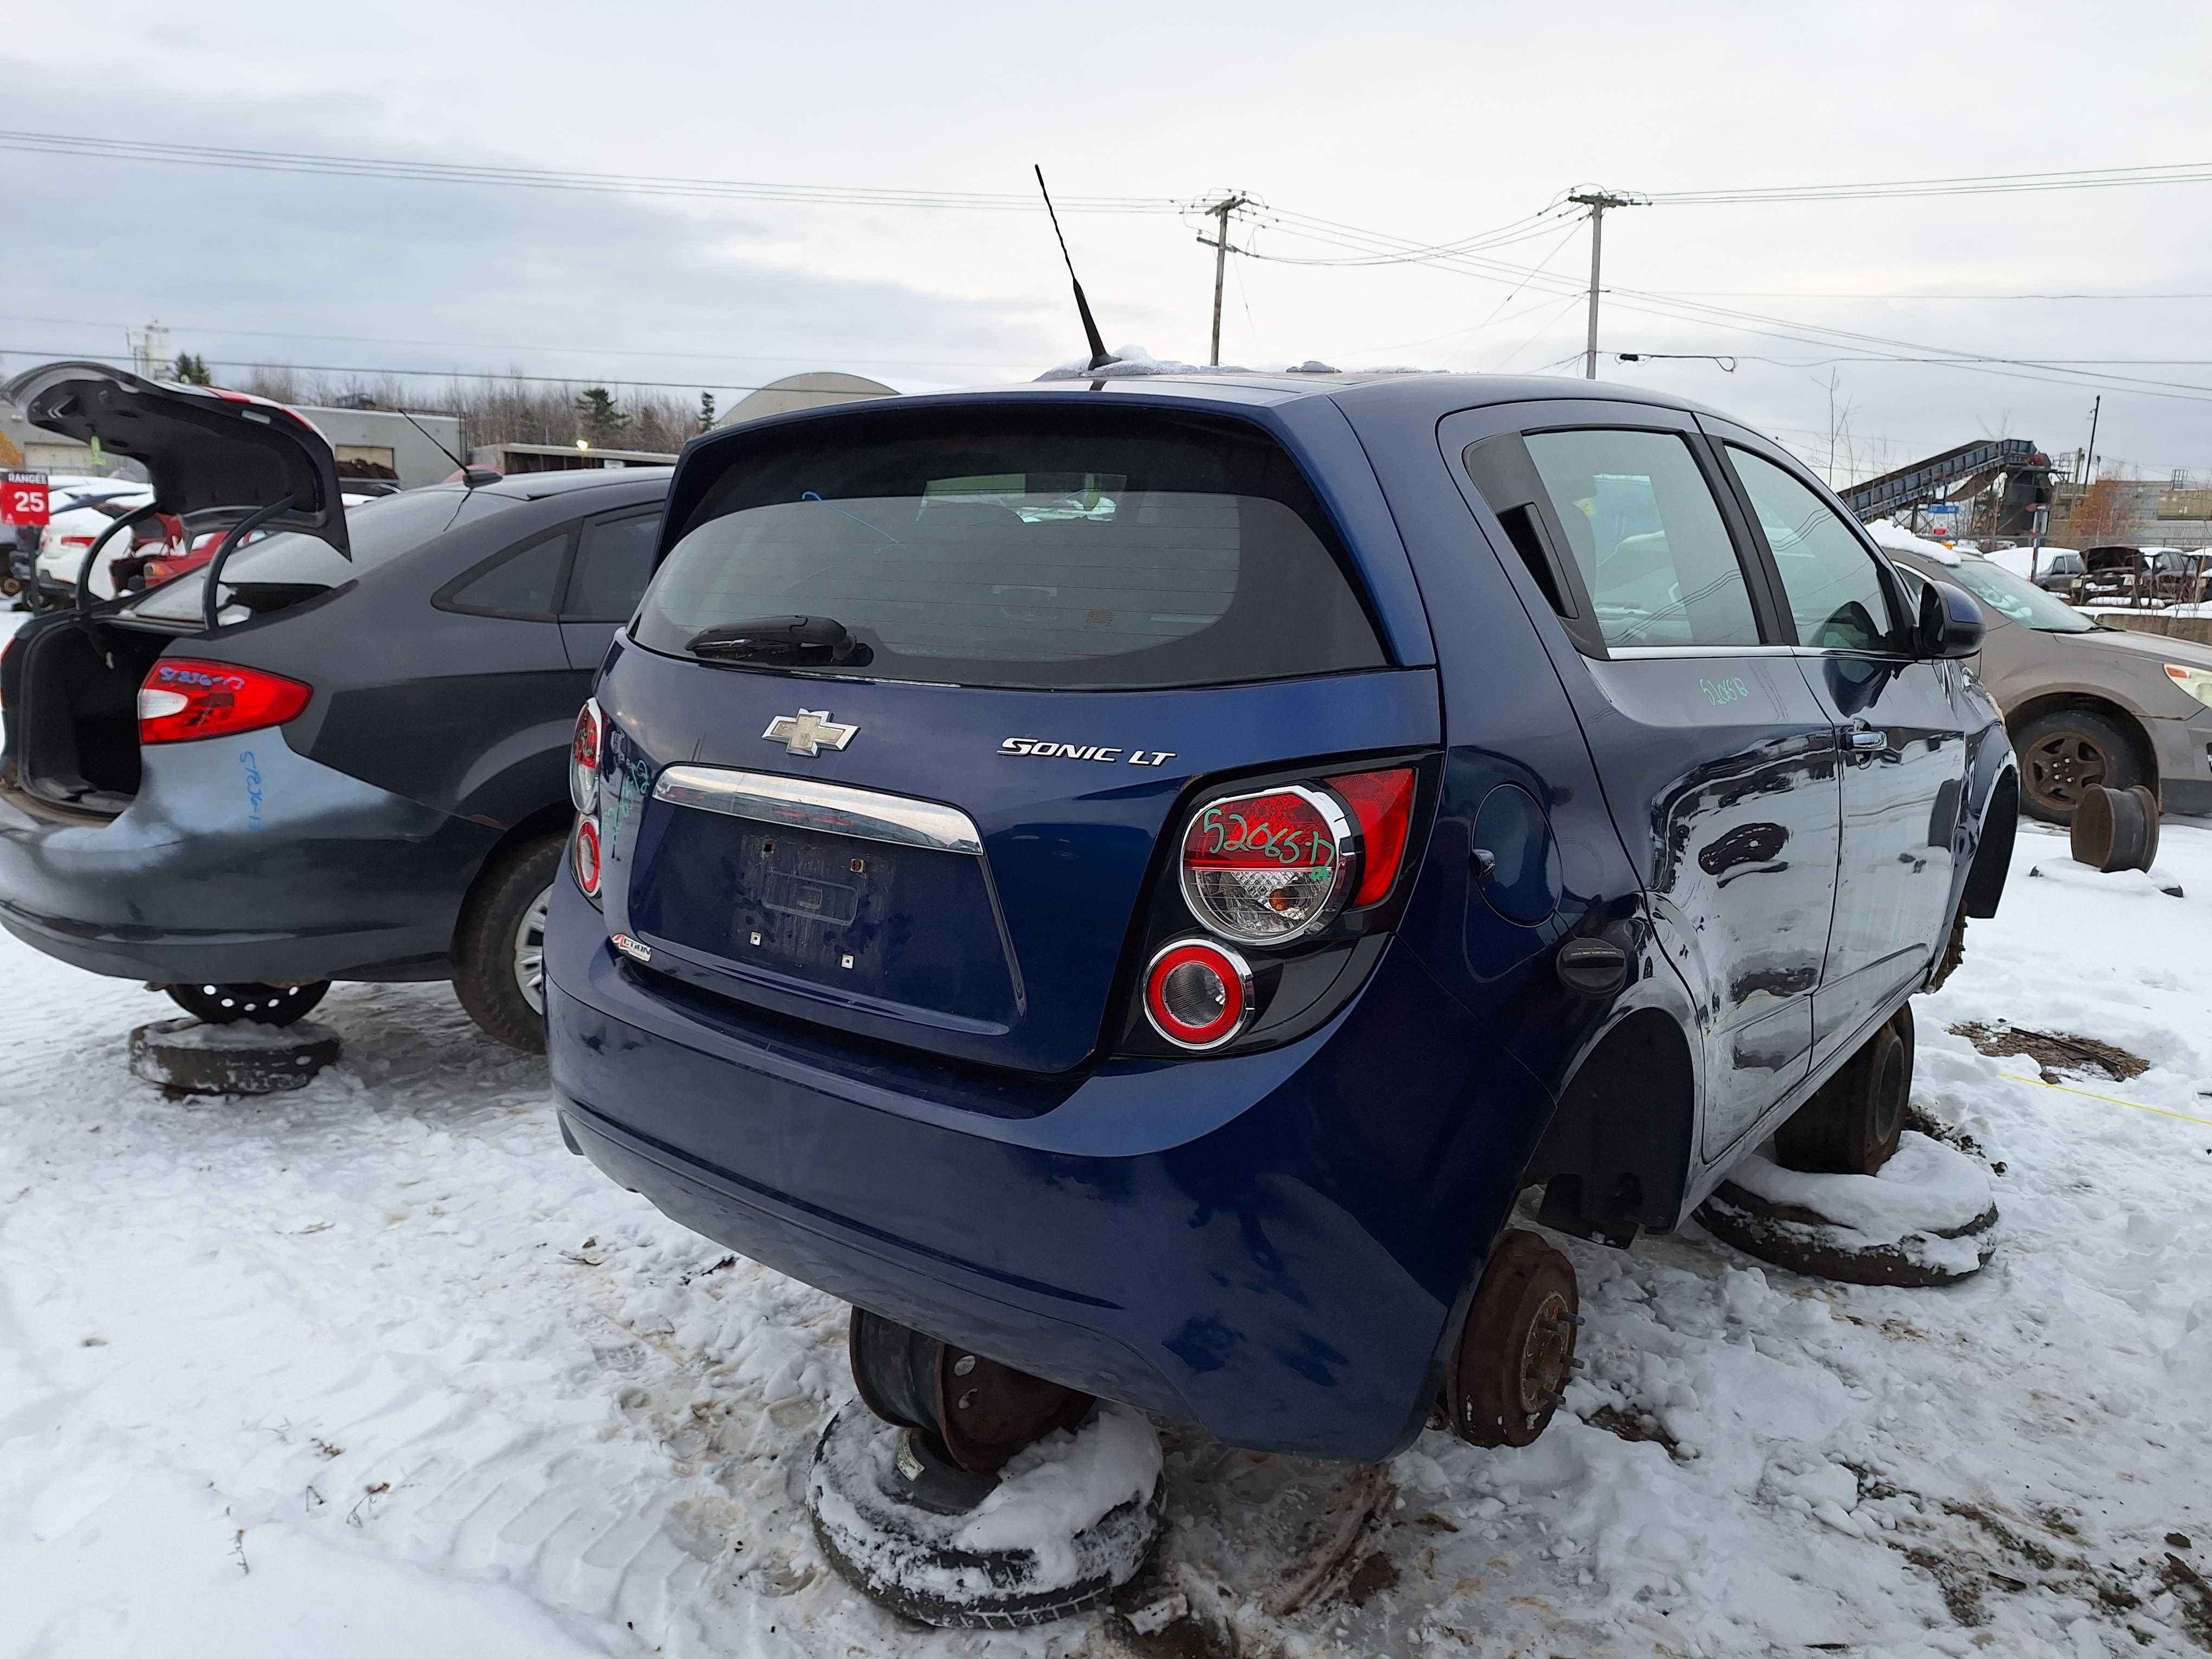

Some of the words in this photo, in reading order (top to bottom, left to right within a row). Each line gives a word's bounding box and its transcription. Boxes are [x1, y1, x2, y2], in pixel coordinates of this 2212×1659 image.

[14, 491, 44, 512] 25
[996, 737, 1123, 762] SONIC
[1128, 750, 1176, 766] LT
